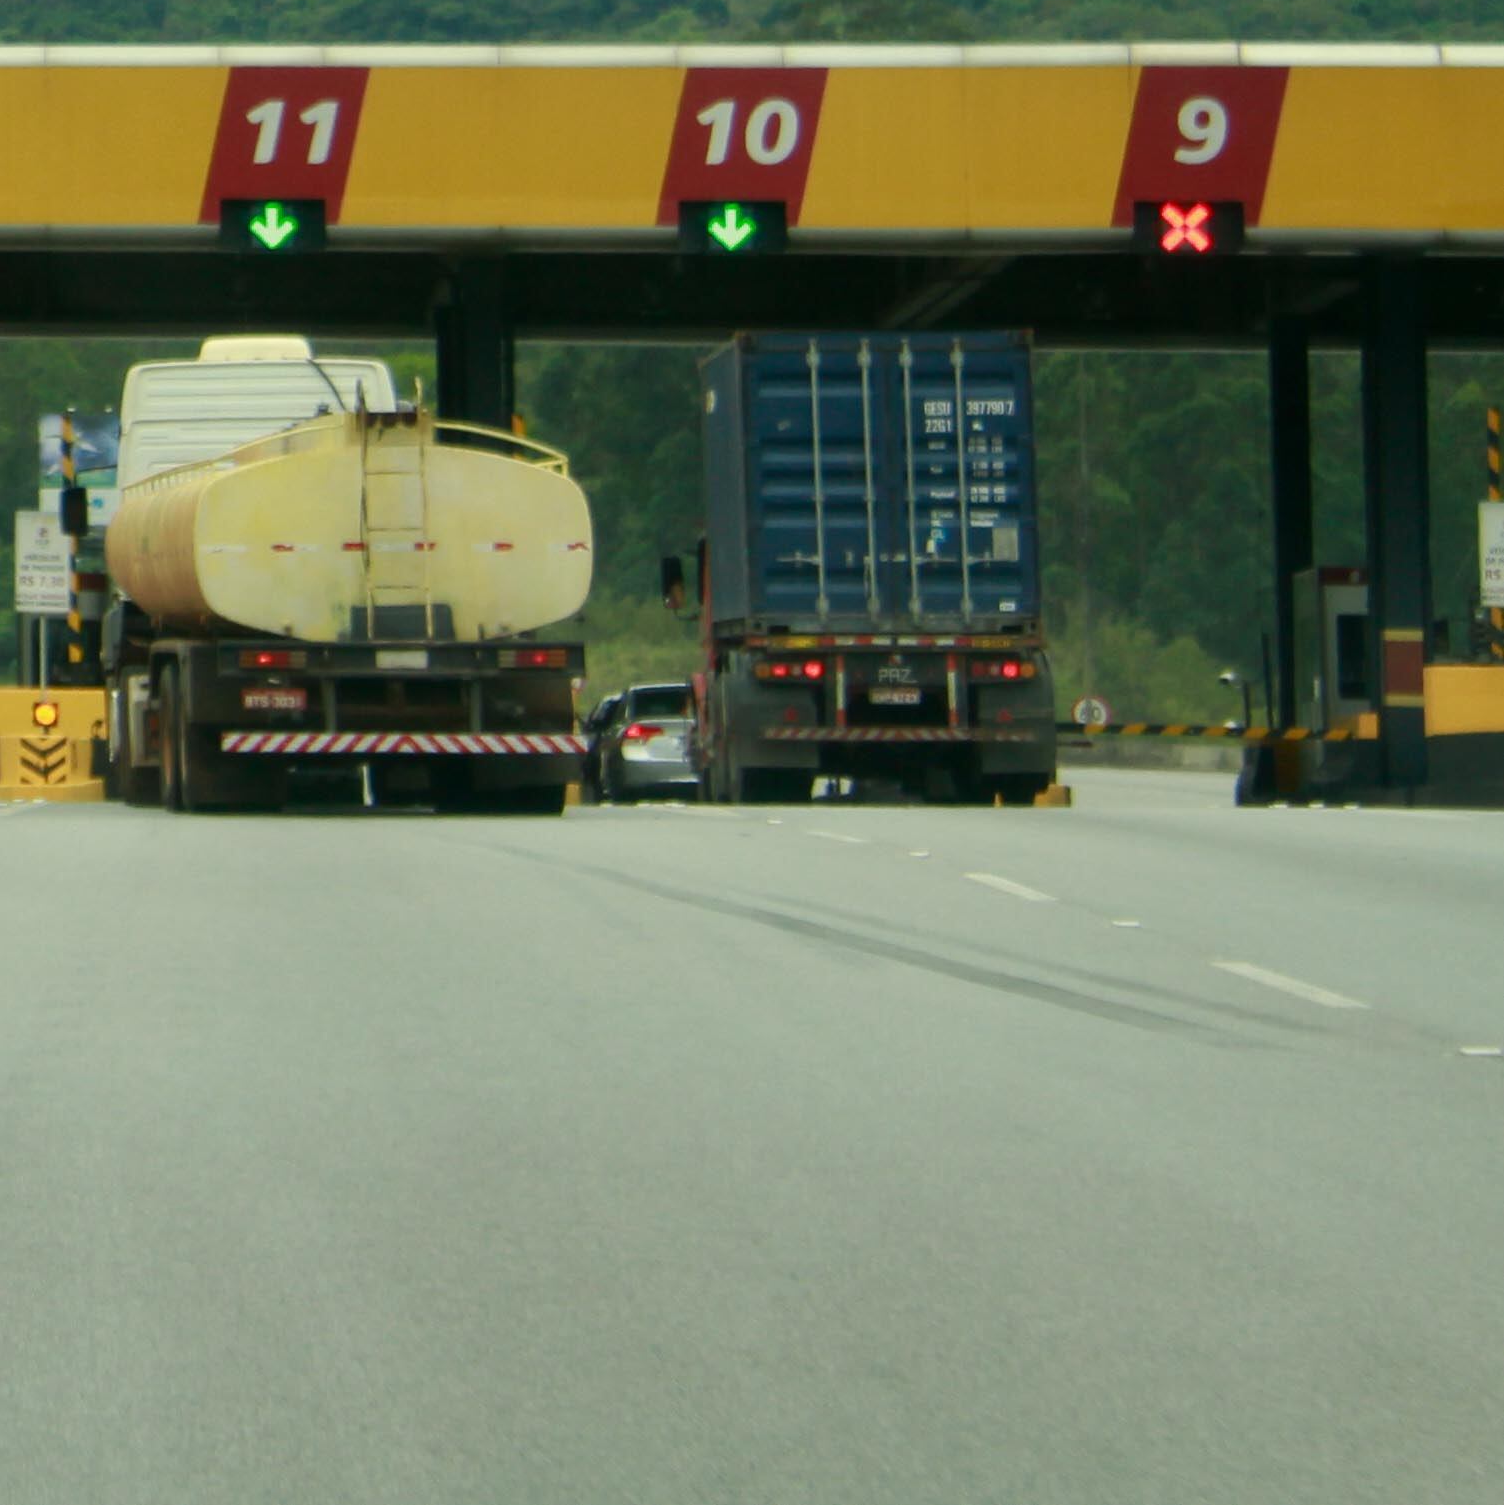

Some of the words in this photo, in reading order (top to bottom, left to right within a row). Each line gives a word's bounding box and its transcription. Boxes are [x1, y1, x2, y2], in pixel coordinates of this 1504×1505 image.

[248, 101, 339, 164] 11
[698, 100, 800, 165] 10
[1178, 99, 1228, 164] 9
